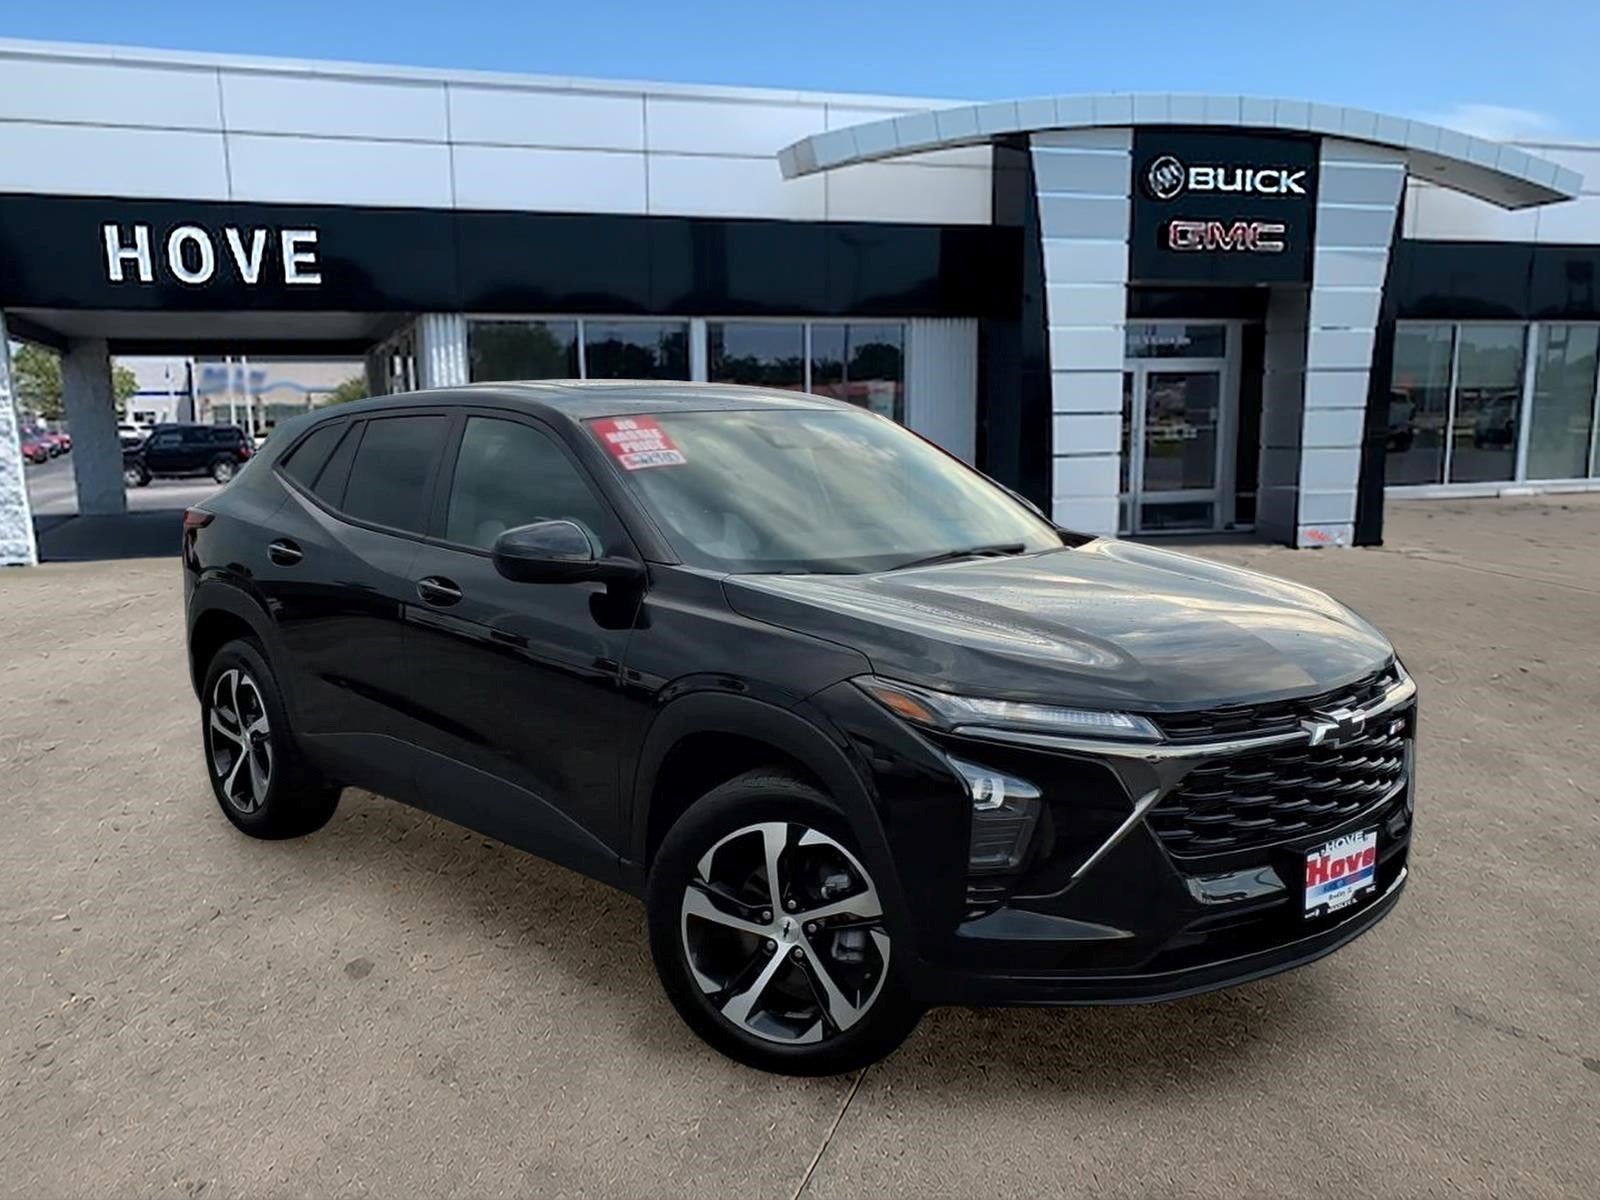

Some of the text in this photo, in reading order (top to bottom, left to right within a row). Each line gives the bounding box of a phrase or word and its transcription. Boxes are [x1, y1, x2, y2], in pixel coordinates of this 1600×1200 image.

[1188, 166, 1307, 195] BUICK
[1168, 220, 1286, 252] GMC
[103, 223, 322, 285] HOVE
[1324, 830, 1365, 851] HOVE
[1306, 846, 1375, 888] Hove
